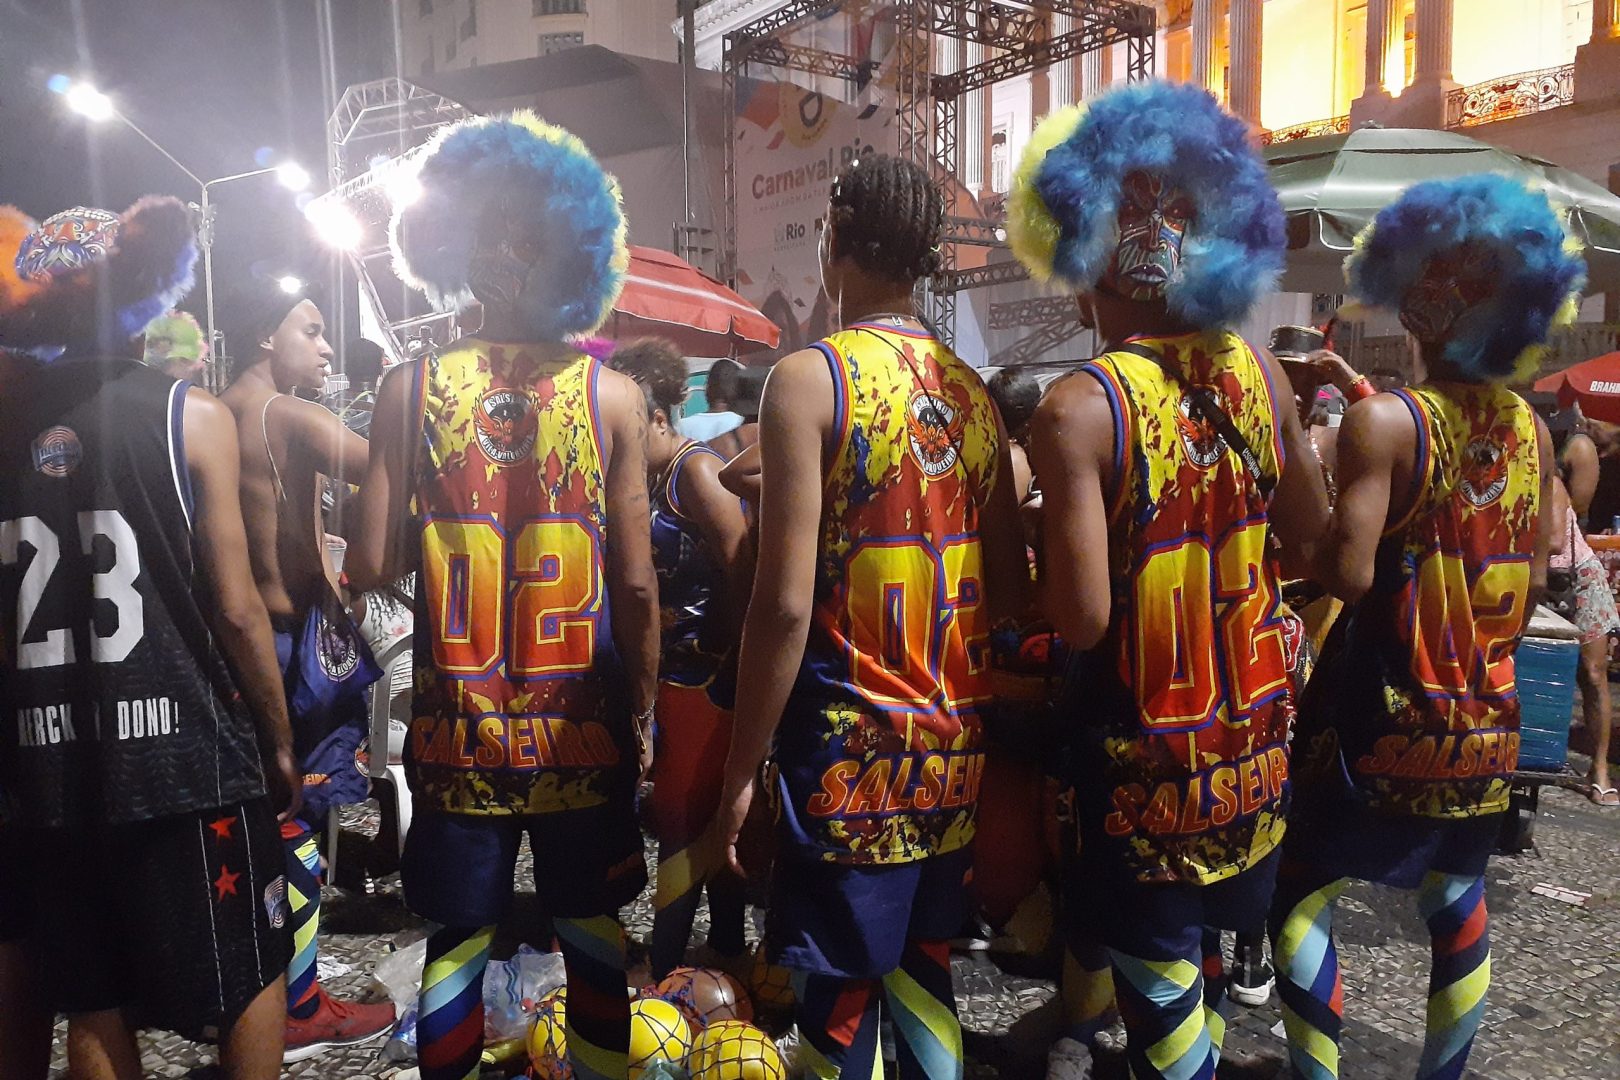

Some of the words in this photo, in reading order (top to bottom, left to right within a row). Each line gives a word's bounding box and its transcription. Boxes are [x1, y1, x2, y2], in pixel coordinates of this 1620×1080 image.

[785, 222, 806, 241] Rio
[1589, 380, 1620, 393] BRAH
[0, 509, 144, 670] 23
[421, 520, 597, 676] 02
[846, 538, 991, 708] 02
[1135, 521, 1288, 728] 02
[117, 697, 179, 740] DONO!
[412, 714, 621, 770] SALSEIRO
